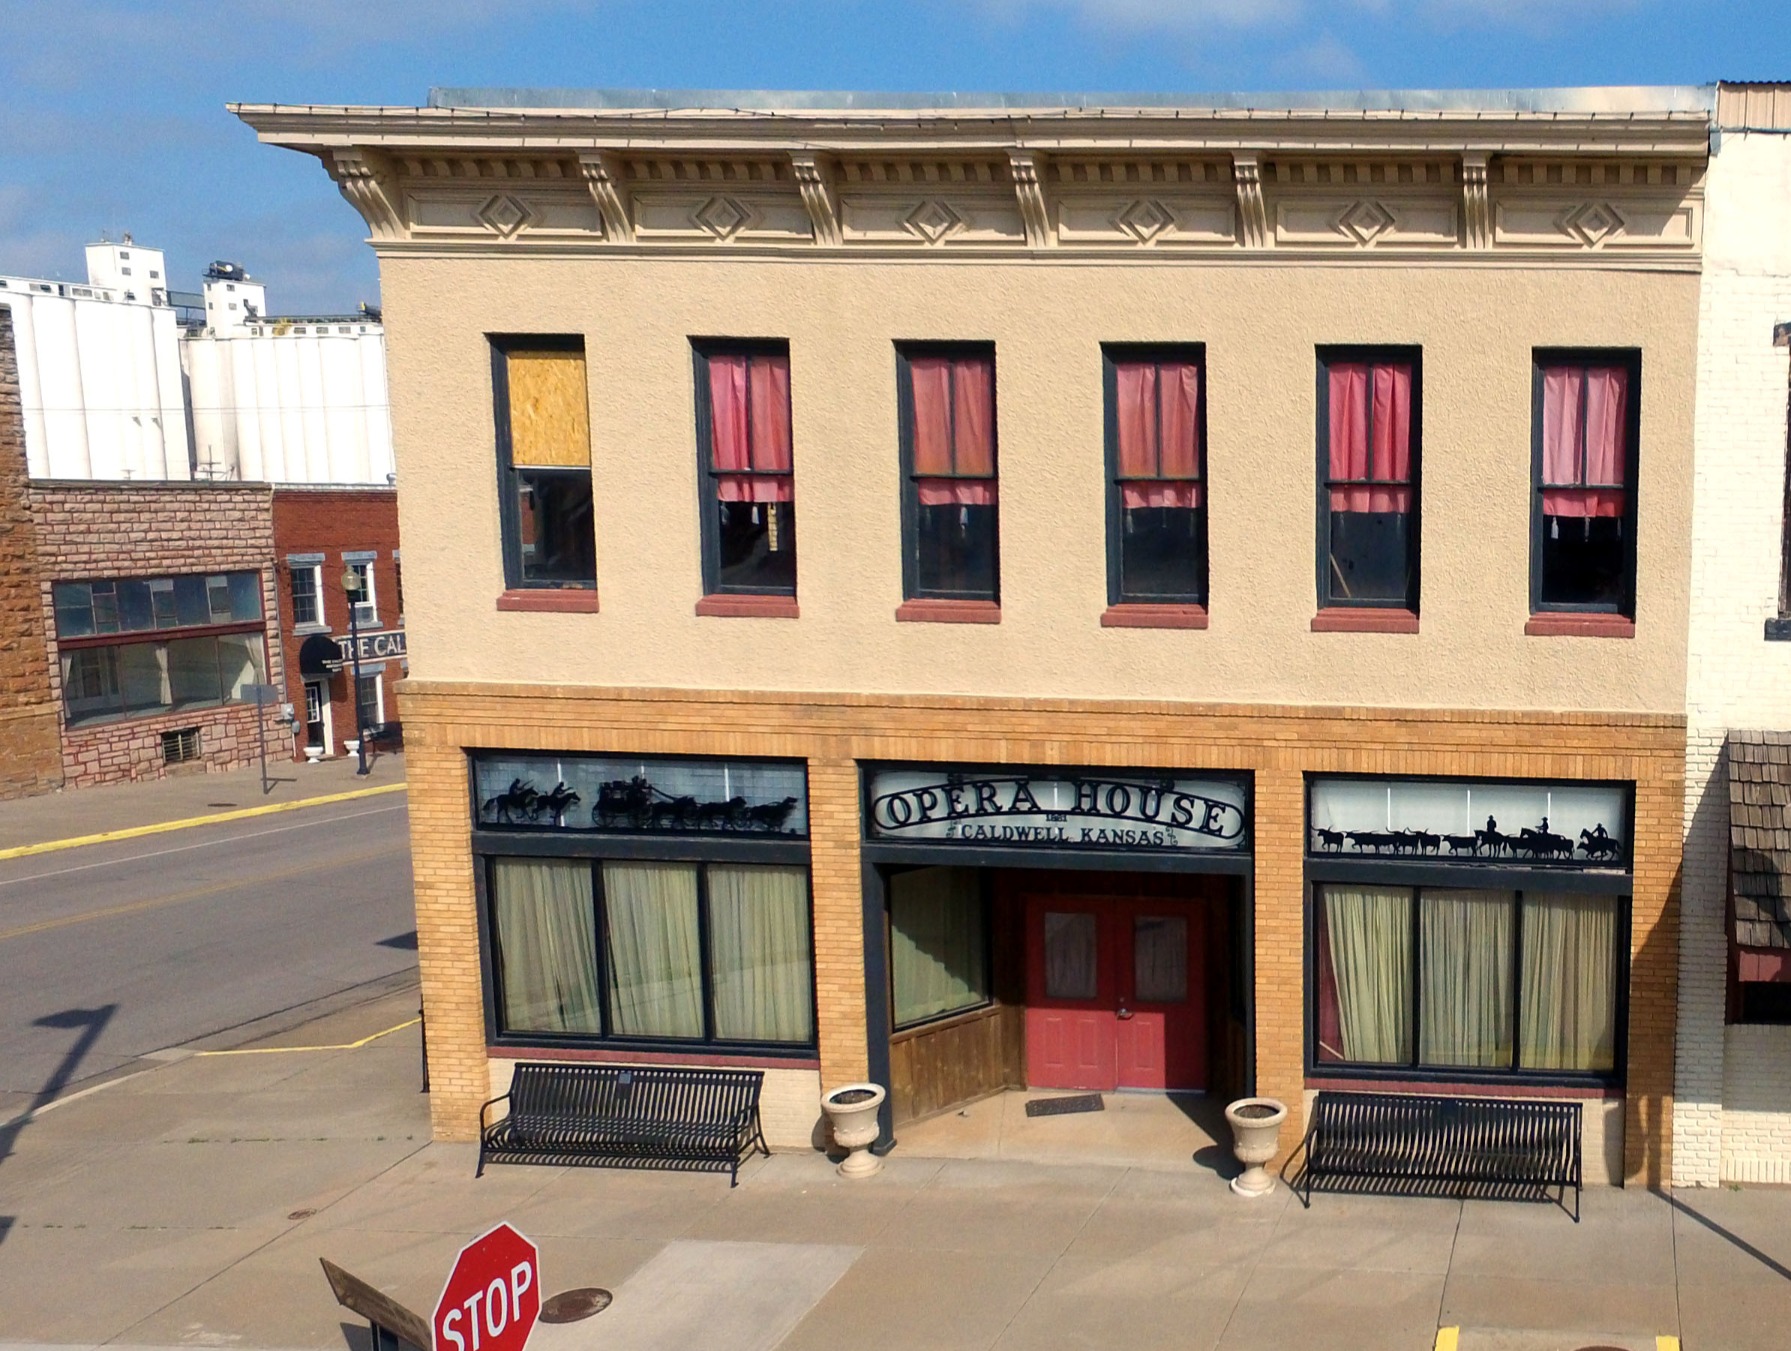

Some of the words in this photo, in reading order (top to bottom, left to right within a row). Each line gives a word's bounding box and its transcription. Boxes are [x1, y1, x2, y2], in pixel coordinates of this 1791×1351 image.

[338, 638, 369, 660] THE
[887, 780, 1042, 825] OPERA
[1069, 781, 1227, 837] HOUSE
[961, 823, 1070, 843] CALDWELL
[1080, 826, 1165, 846] KANSAS
[442, 1260, 532, 1351] STOP
